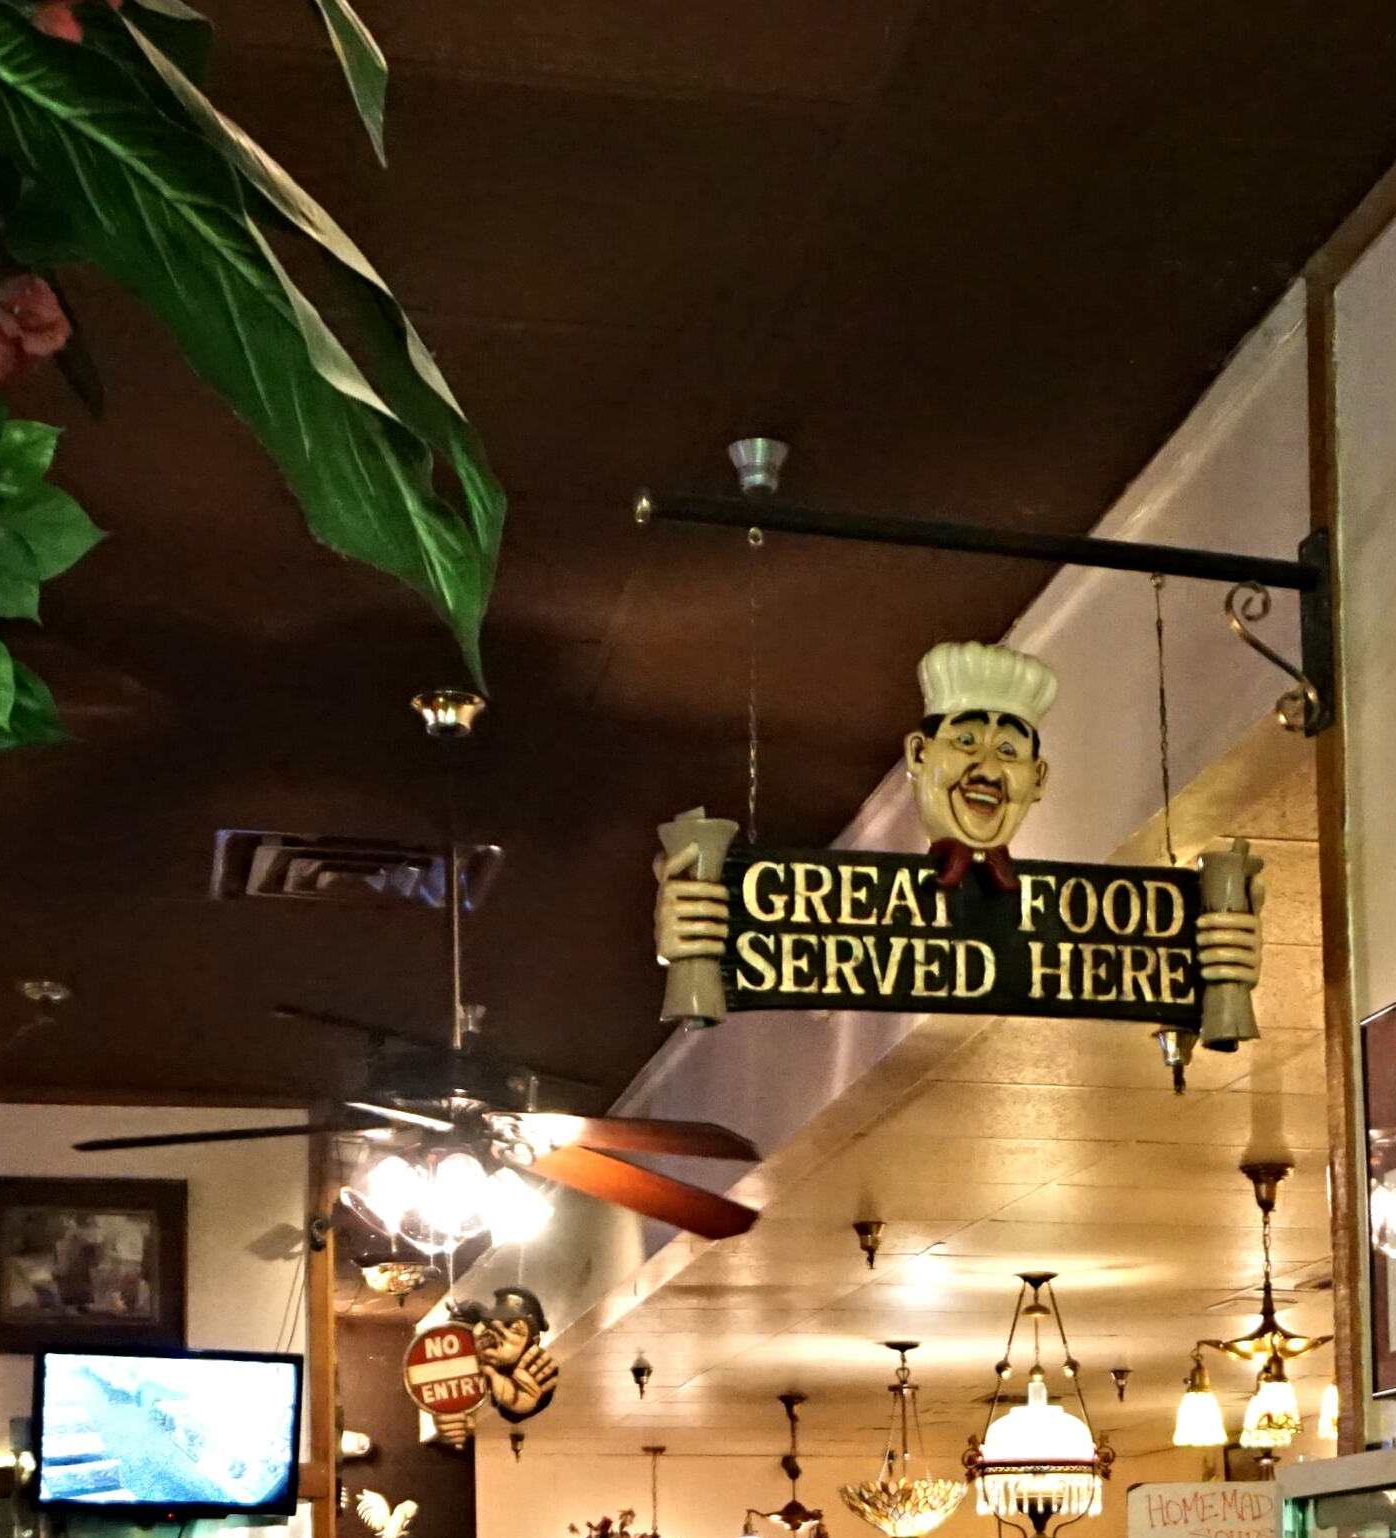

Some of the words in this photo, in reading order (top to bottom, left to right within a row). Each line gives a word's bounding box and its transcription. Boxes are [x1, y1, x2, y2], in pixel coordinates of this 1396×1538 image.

[742, 860, 953, 928] GREAT
[1017, 874, 1185, 939] FOOD
[736, 932, 996, 998] SERVED
[1027, 942, 1198, 1004] HERE
[424, 1334, 459, 1359] NO
[421, 1376, 485, 1403] ENTRY
[1146, 1489, 1273, 1528] HOMEMAD
